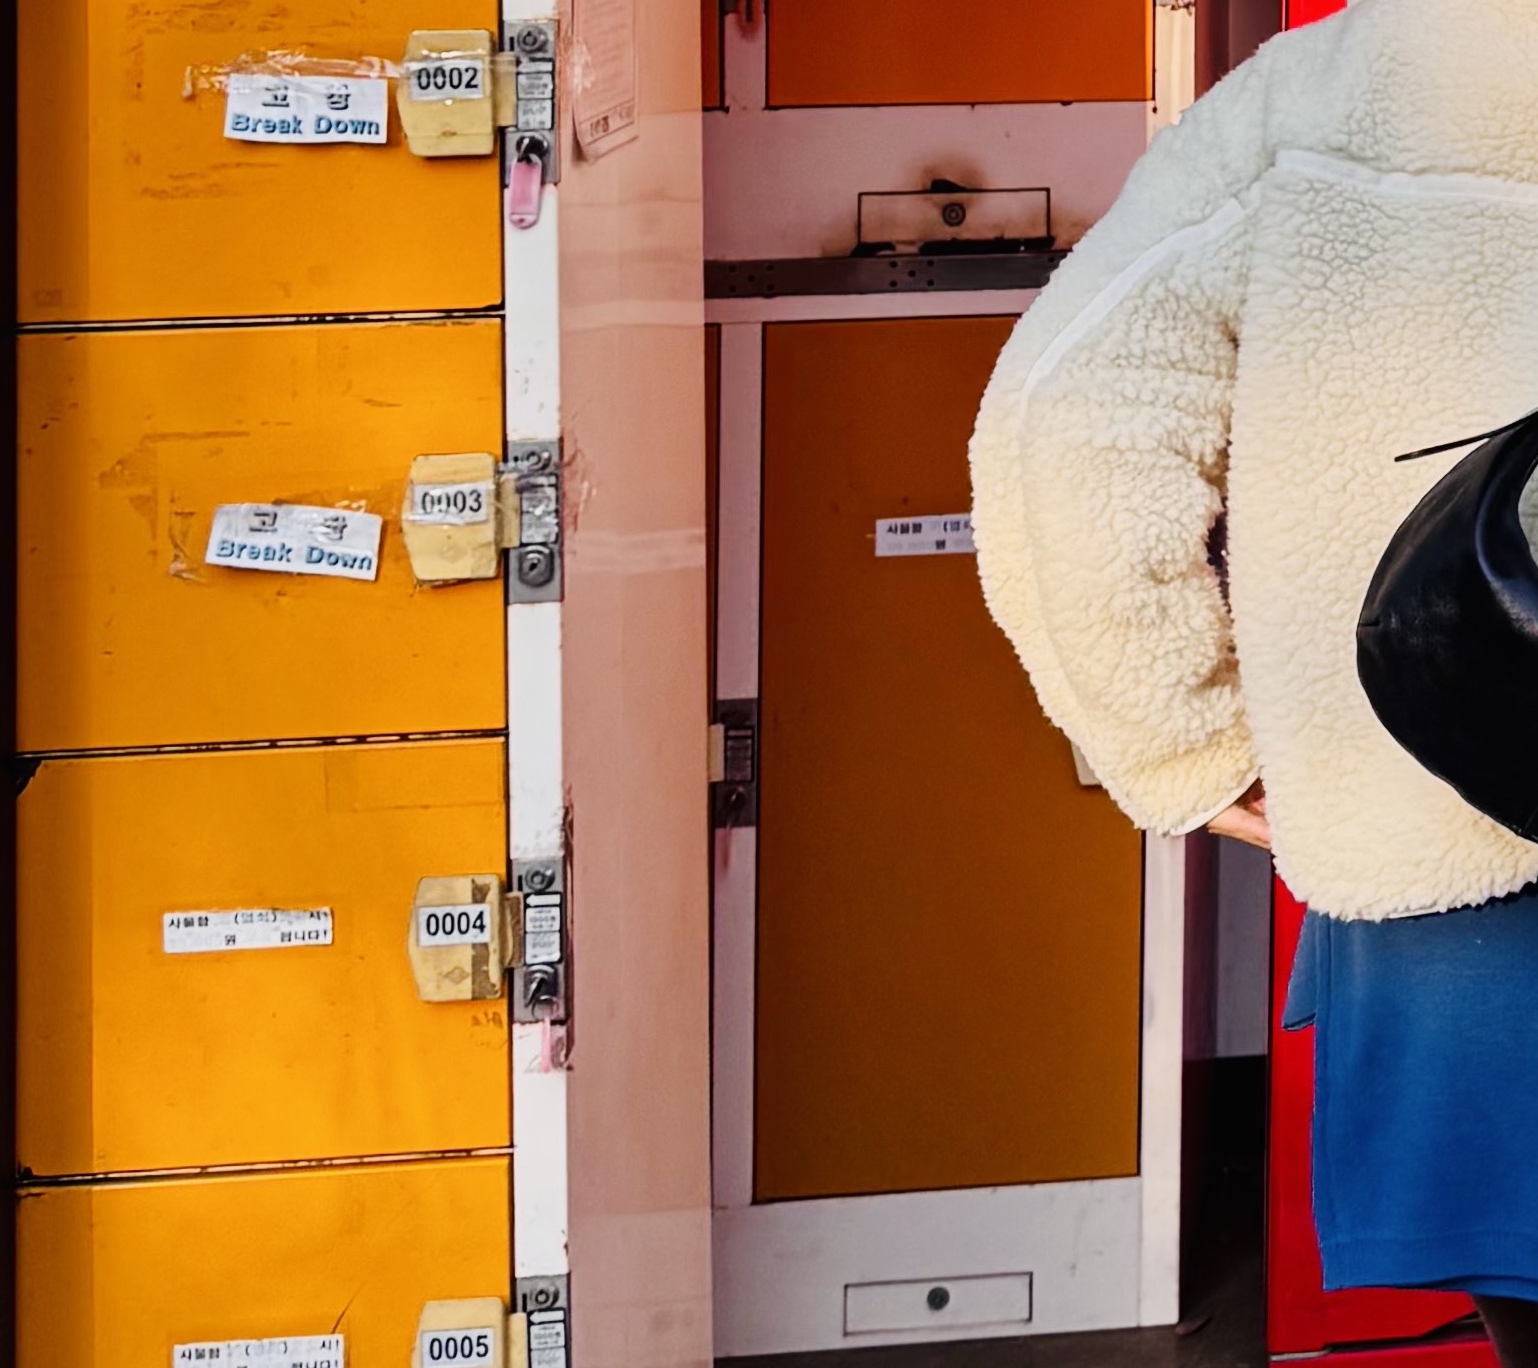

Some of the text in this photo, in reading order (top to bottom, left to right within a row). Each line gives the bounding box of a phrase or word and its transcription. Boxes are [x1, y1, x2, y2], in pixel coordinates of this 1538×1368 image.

[417, 67, 480, 90] 0002
[231, 113, 380, 137] Break Down
[421, 489, 483, 514] 0003
[215, 538, 373, 573] Break Down
[425, 911, 487, 937] 0004
[428, 1335, 489, 1362] 0005
